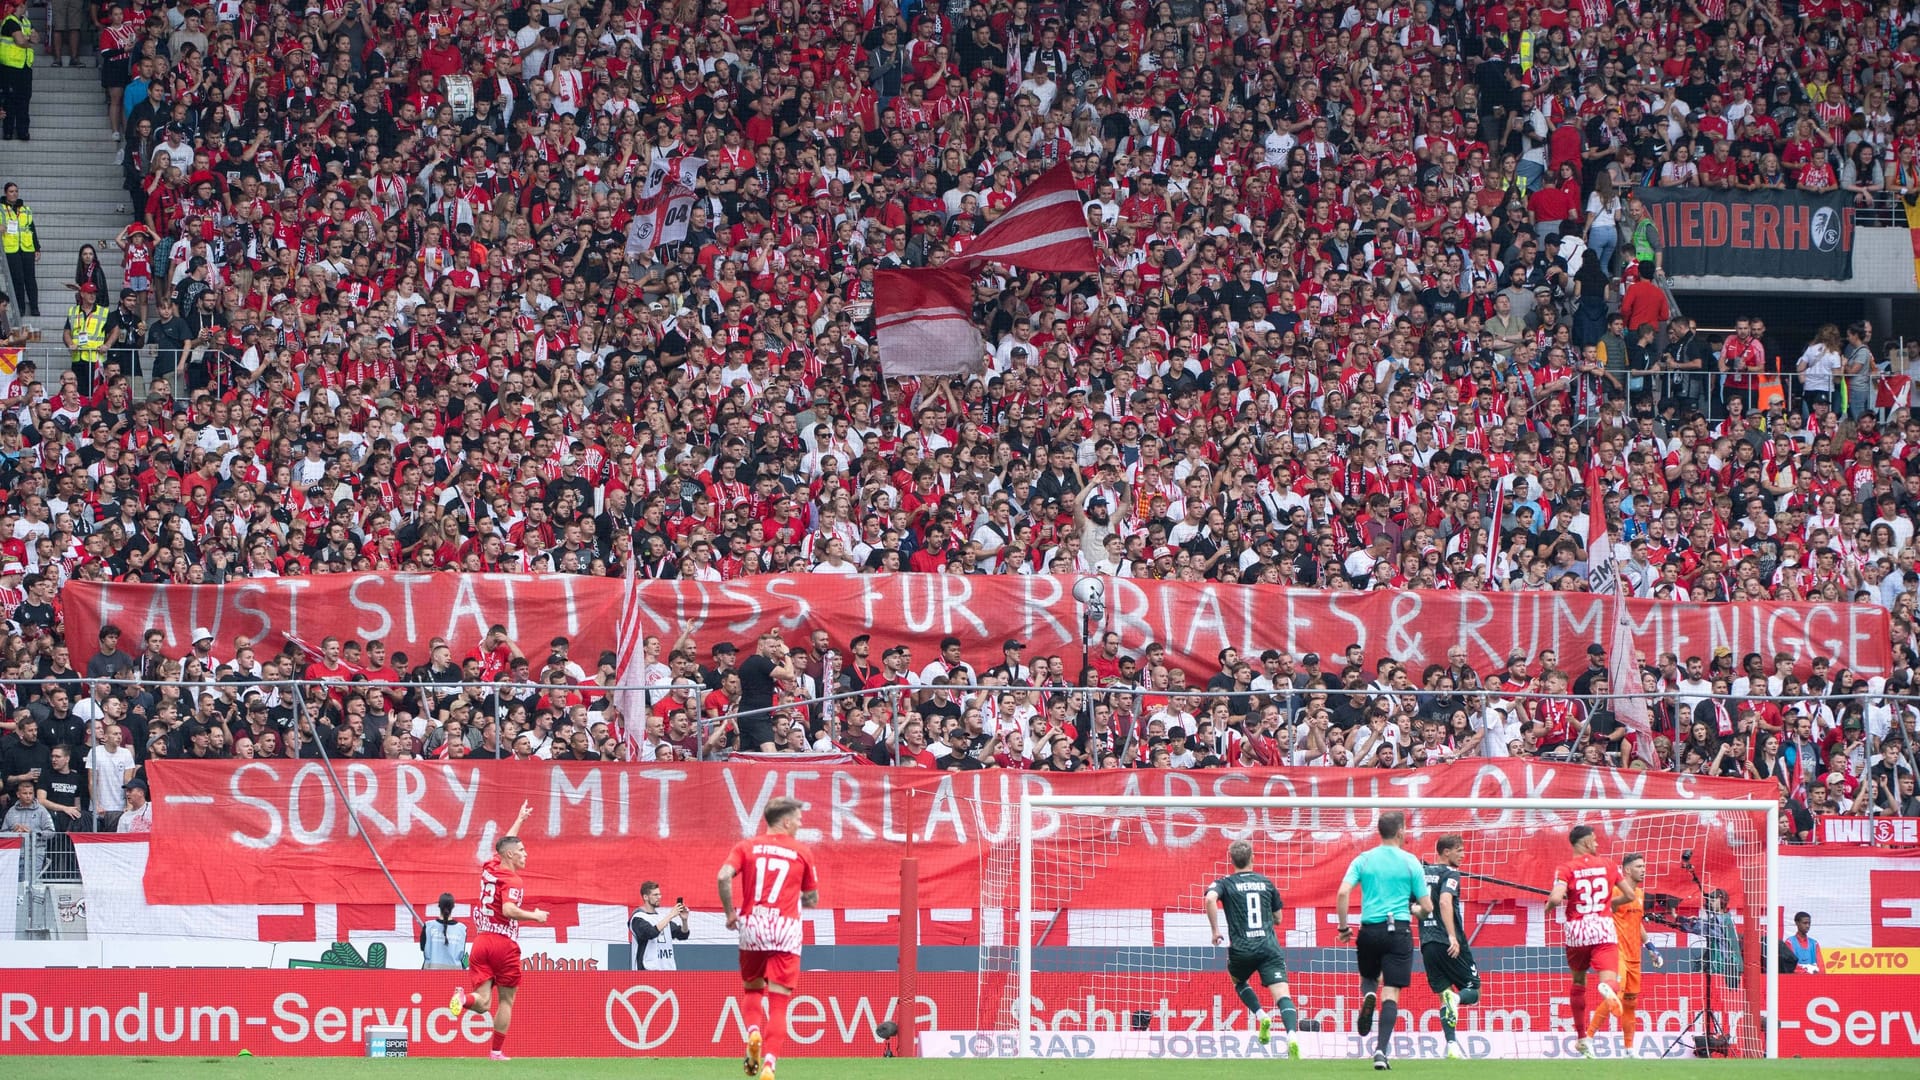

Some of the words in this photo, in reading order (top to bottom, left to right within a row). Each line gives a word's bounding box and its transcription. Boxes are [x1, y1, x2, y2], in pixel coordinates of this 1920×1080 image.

[665, 204, 689, 226] 04
[98, 580, 310, 648] FAUST
[349, 573, 579, 643] STATT
[1386, 591, 1427, 662] &
[230, 762, 496, 863] SORRY,
[548, 765, 687, 838] MIT
[1472, 764, 1647, 839] OKAY
[754, 857, 790, 903] 17
[1576, 877, 1609, 913] 32
[1246, 892, 1262, 928] 8
[1851, 951, 1909, 969] LOTTO
